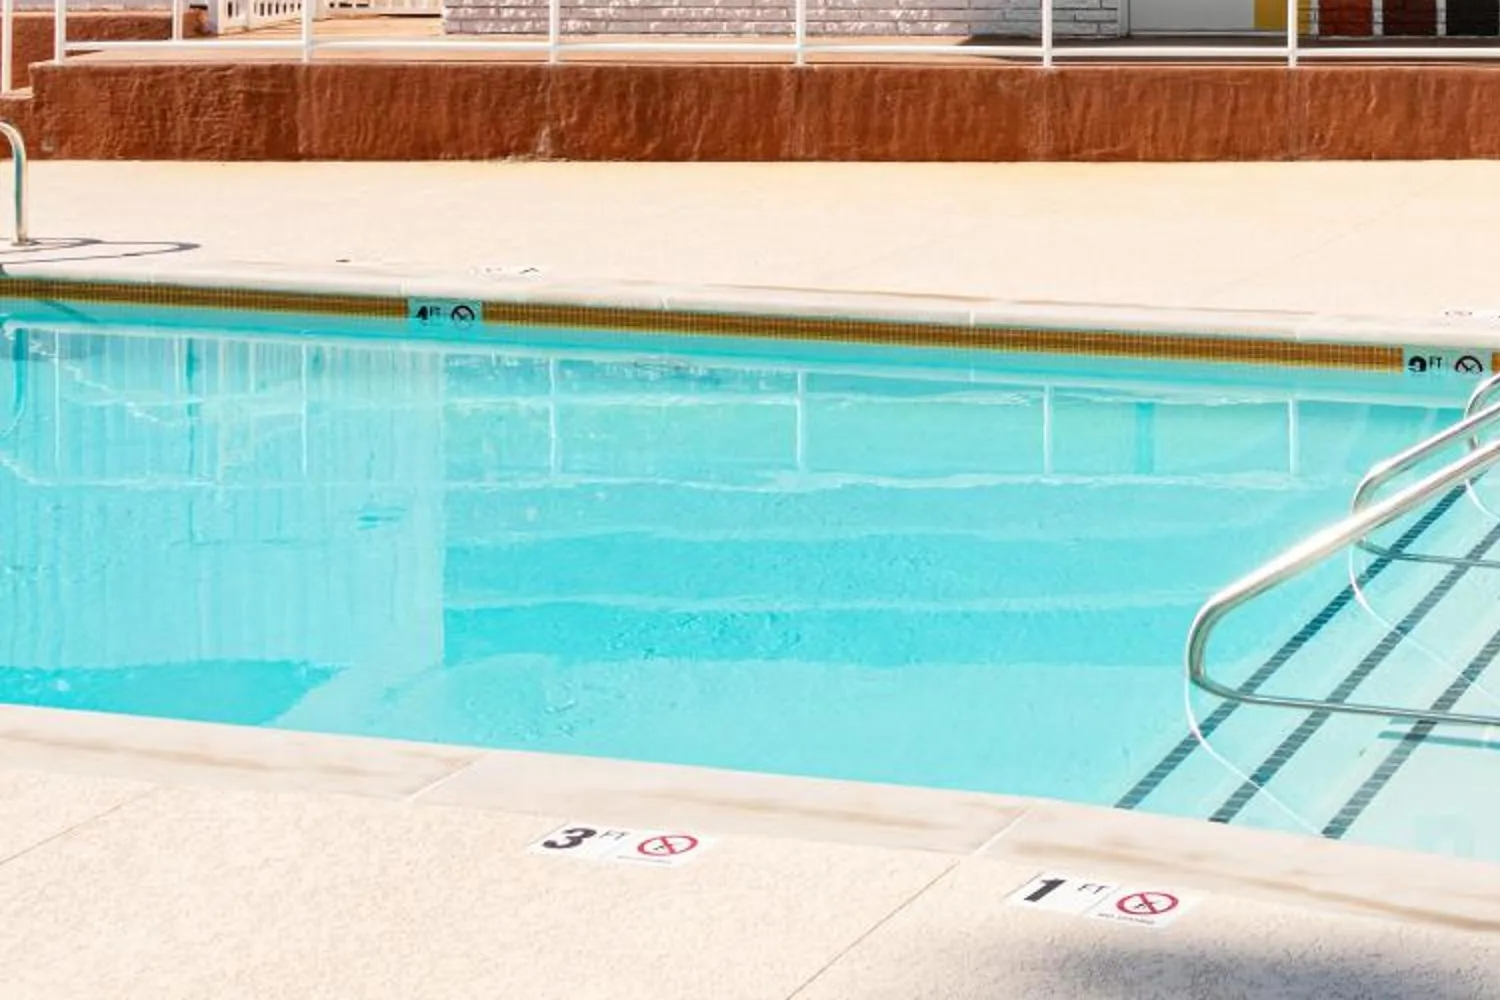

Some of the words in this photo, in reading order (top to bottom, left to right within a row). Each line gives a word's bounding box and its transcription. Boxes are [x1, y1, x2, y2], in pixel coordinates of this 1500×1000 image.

[1429, 356, 1442, 369] FT
[543, 828, 597, 849] 3
[600, 830, 631, 840] FT
[1024, 878, 1067, 902] 1
